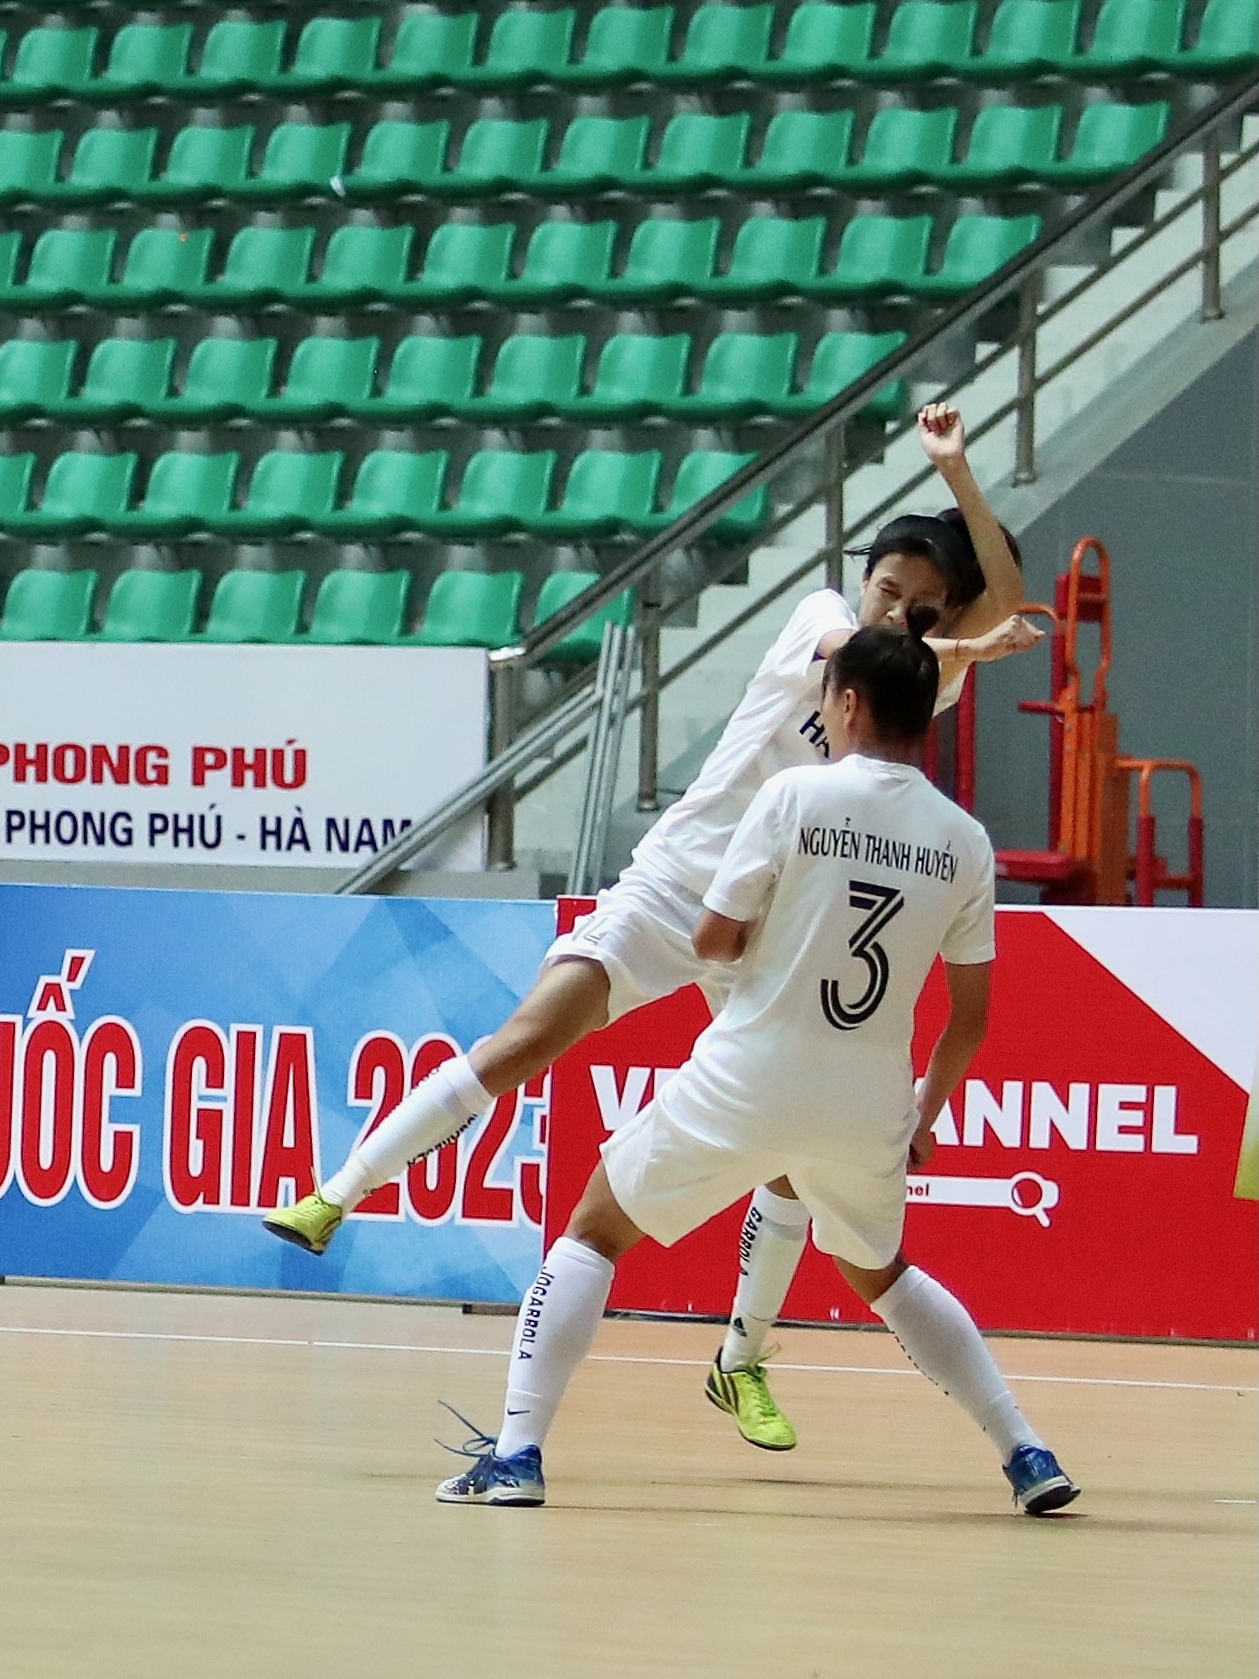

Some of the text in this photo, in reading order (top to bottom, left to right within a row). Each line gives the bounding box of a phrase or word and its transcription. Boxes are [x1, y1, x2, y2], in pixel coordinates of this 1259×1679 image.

[191, 738, 307, 790] PHÚ
[6, 809, 134, 848] PHONG
[148, 802, 223, 849] PHÚ
[259, 806, 312, 853] HÀ
[325, 816, 413, 854] NAM
[865, 834, 911, 872] THANH
[820, 879, 905, 1031] 3
[162, 1018, 322, 1215] GIA
